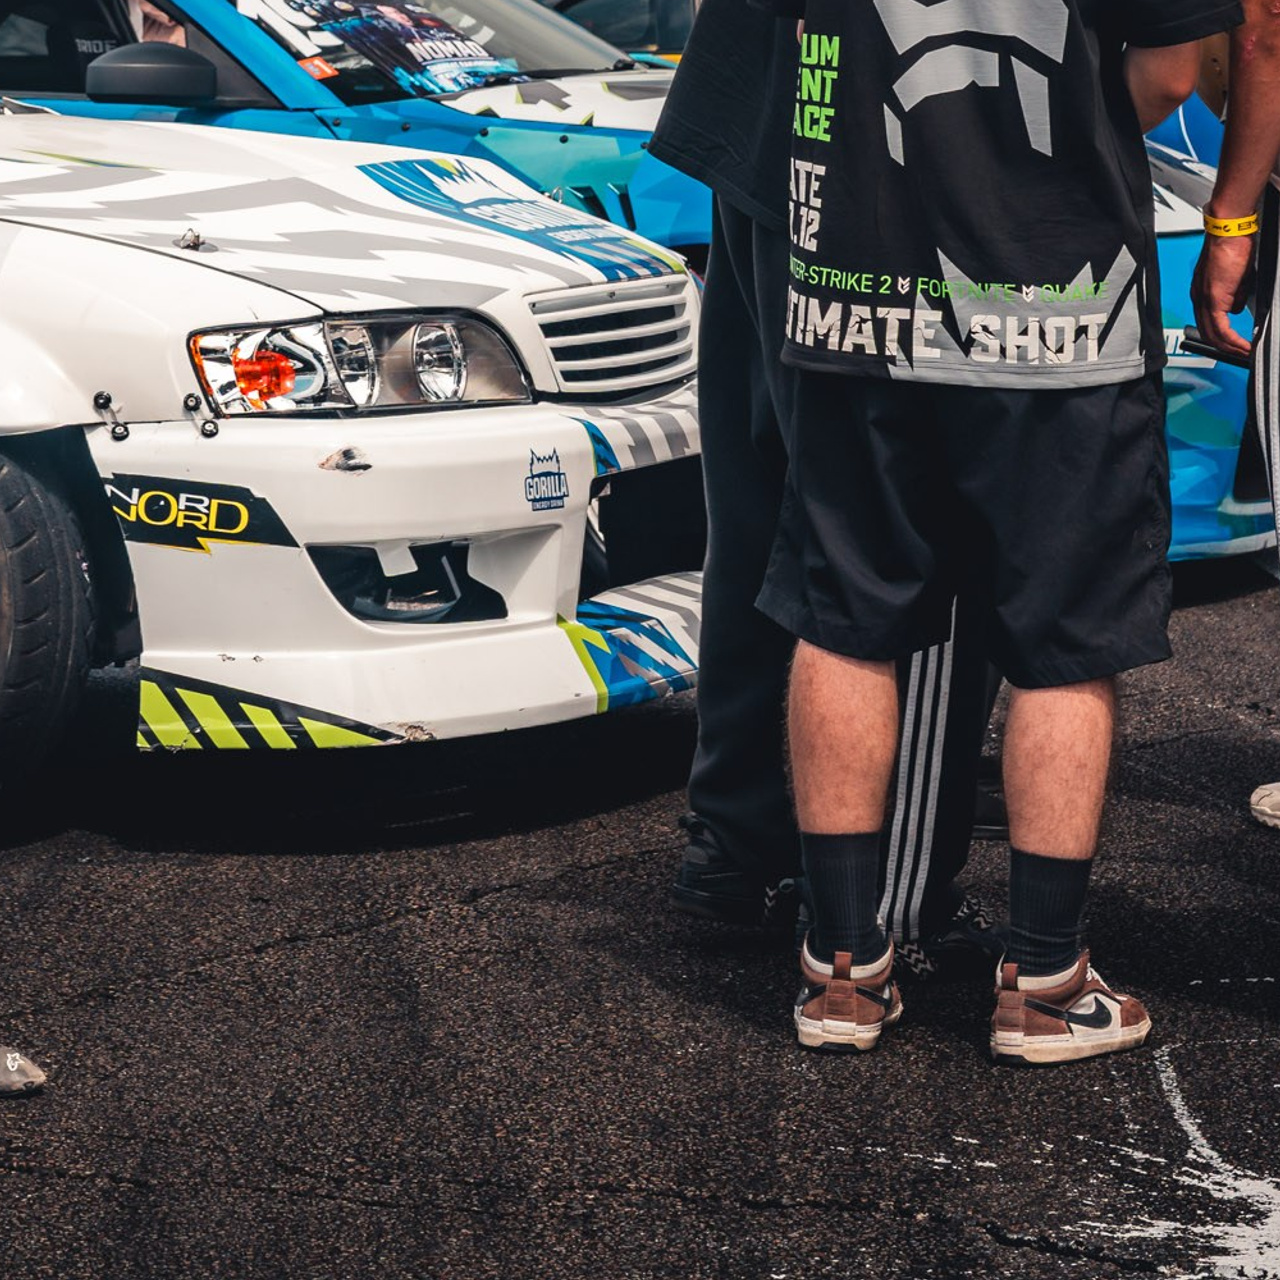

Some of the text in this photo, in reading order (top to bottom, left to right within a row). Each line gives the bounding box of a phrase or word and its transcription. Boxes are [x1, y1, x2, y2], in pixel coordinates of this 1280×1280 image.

[405, 40, 489, 62] NOMAD
[796, 67, 838, 104] NT
[879, 275, 892, 295] 2
[917, 277, 1016, 304] FORTNITE
[1039, 281, 1110, 303] QUAKE
[970, 312, 1108, 365] SHOT
[526, 474, 568, 500] GORILLA
[104, 483, 250, 534] NORD
